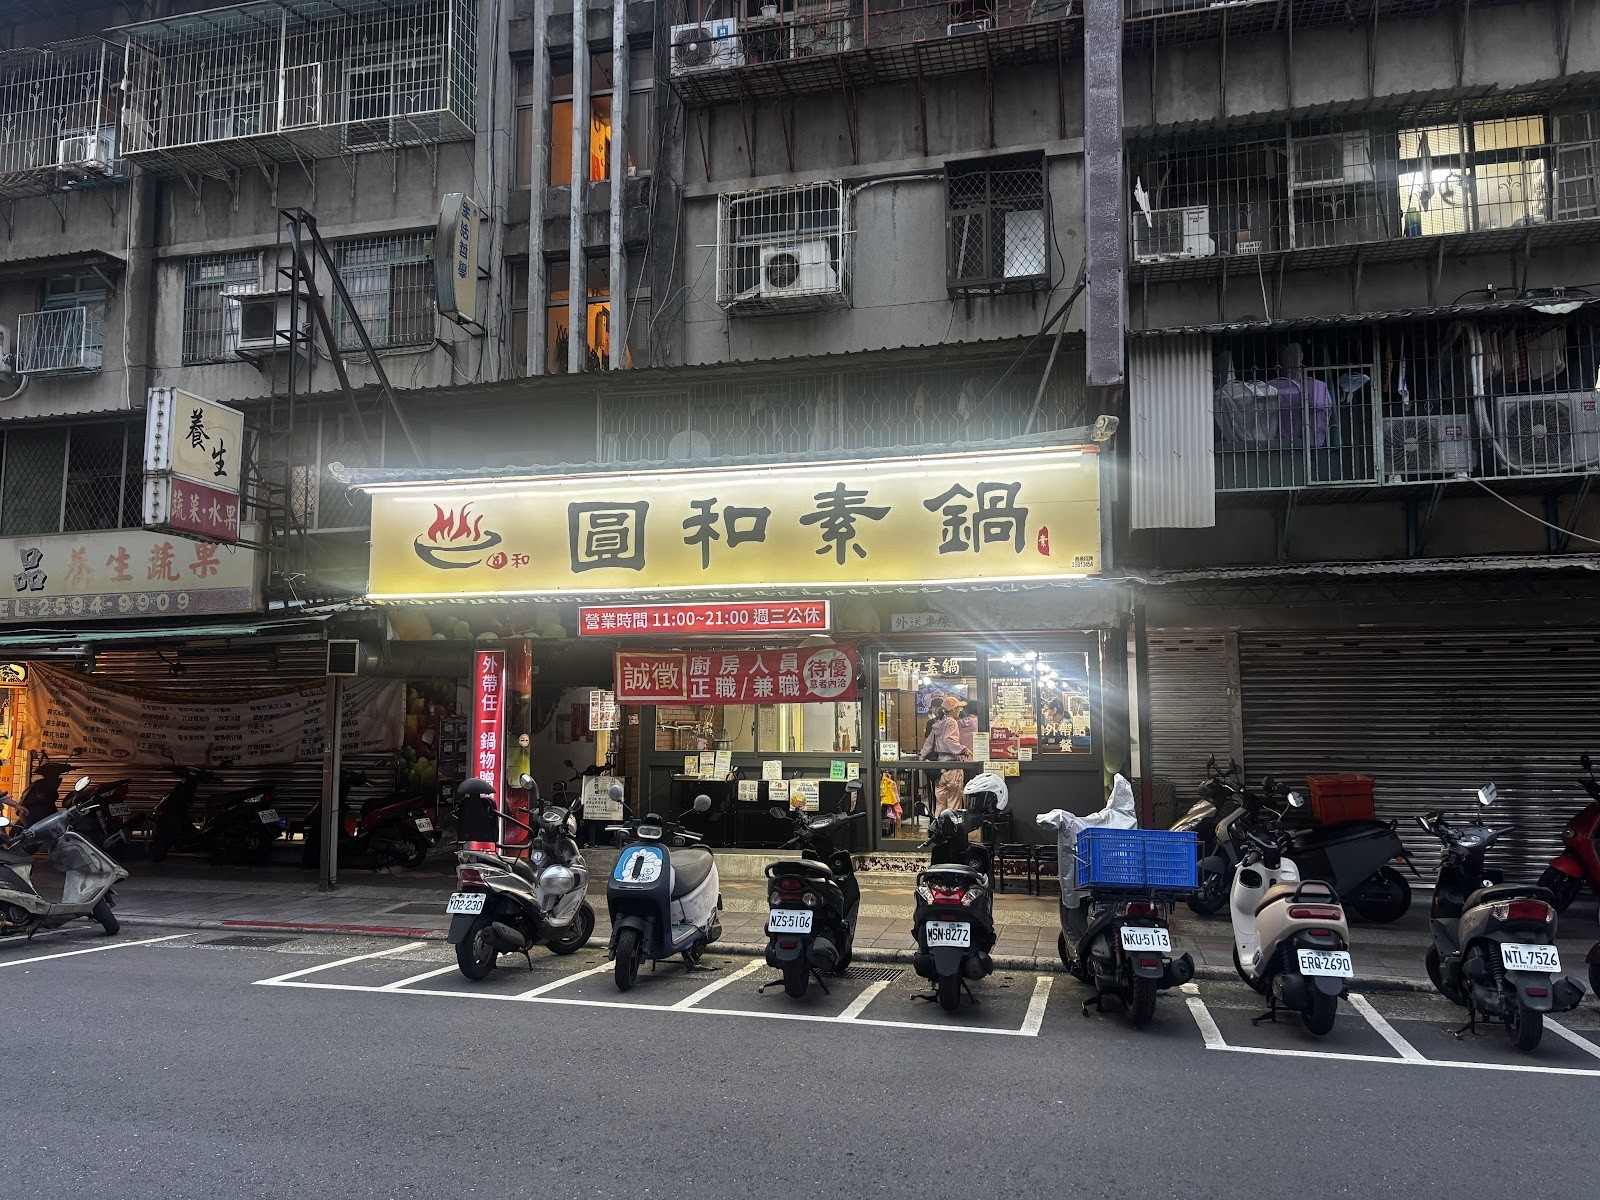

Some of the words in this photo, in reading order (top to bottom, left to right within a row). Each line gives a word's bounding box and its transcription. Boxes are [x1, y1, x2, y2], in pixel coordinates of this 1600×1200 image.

[186, 407, 227, 477] 養生
[568, 482, 1029, 574] 圓和素鍋
[13, 547, 48, 592] 品
[64, 541, 221, 587] 養生蔬果
[585, 612, 648, 630] 營業時間
[652, 610, 749, 627] 11:00~21:00
[753, 607, 821, 625] 週三公休
[623, 662, 679, 690] 誠徵
[690, 652, 799, 676] 廚房人員
[808, 658, 847, 679] 待優
[690, 675, 800, 699] 正職/兼職
[479, 656, 498, 798] 外帶任一鍋物贈
